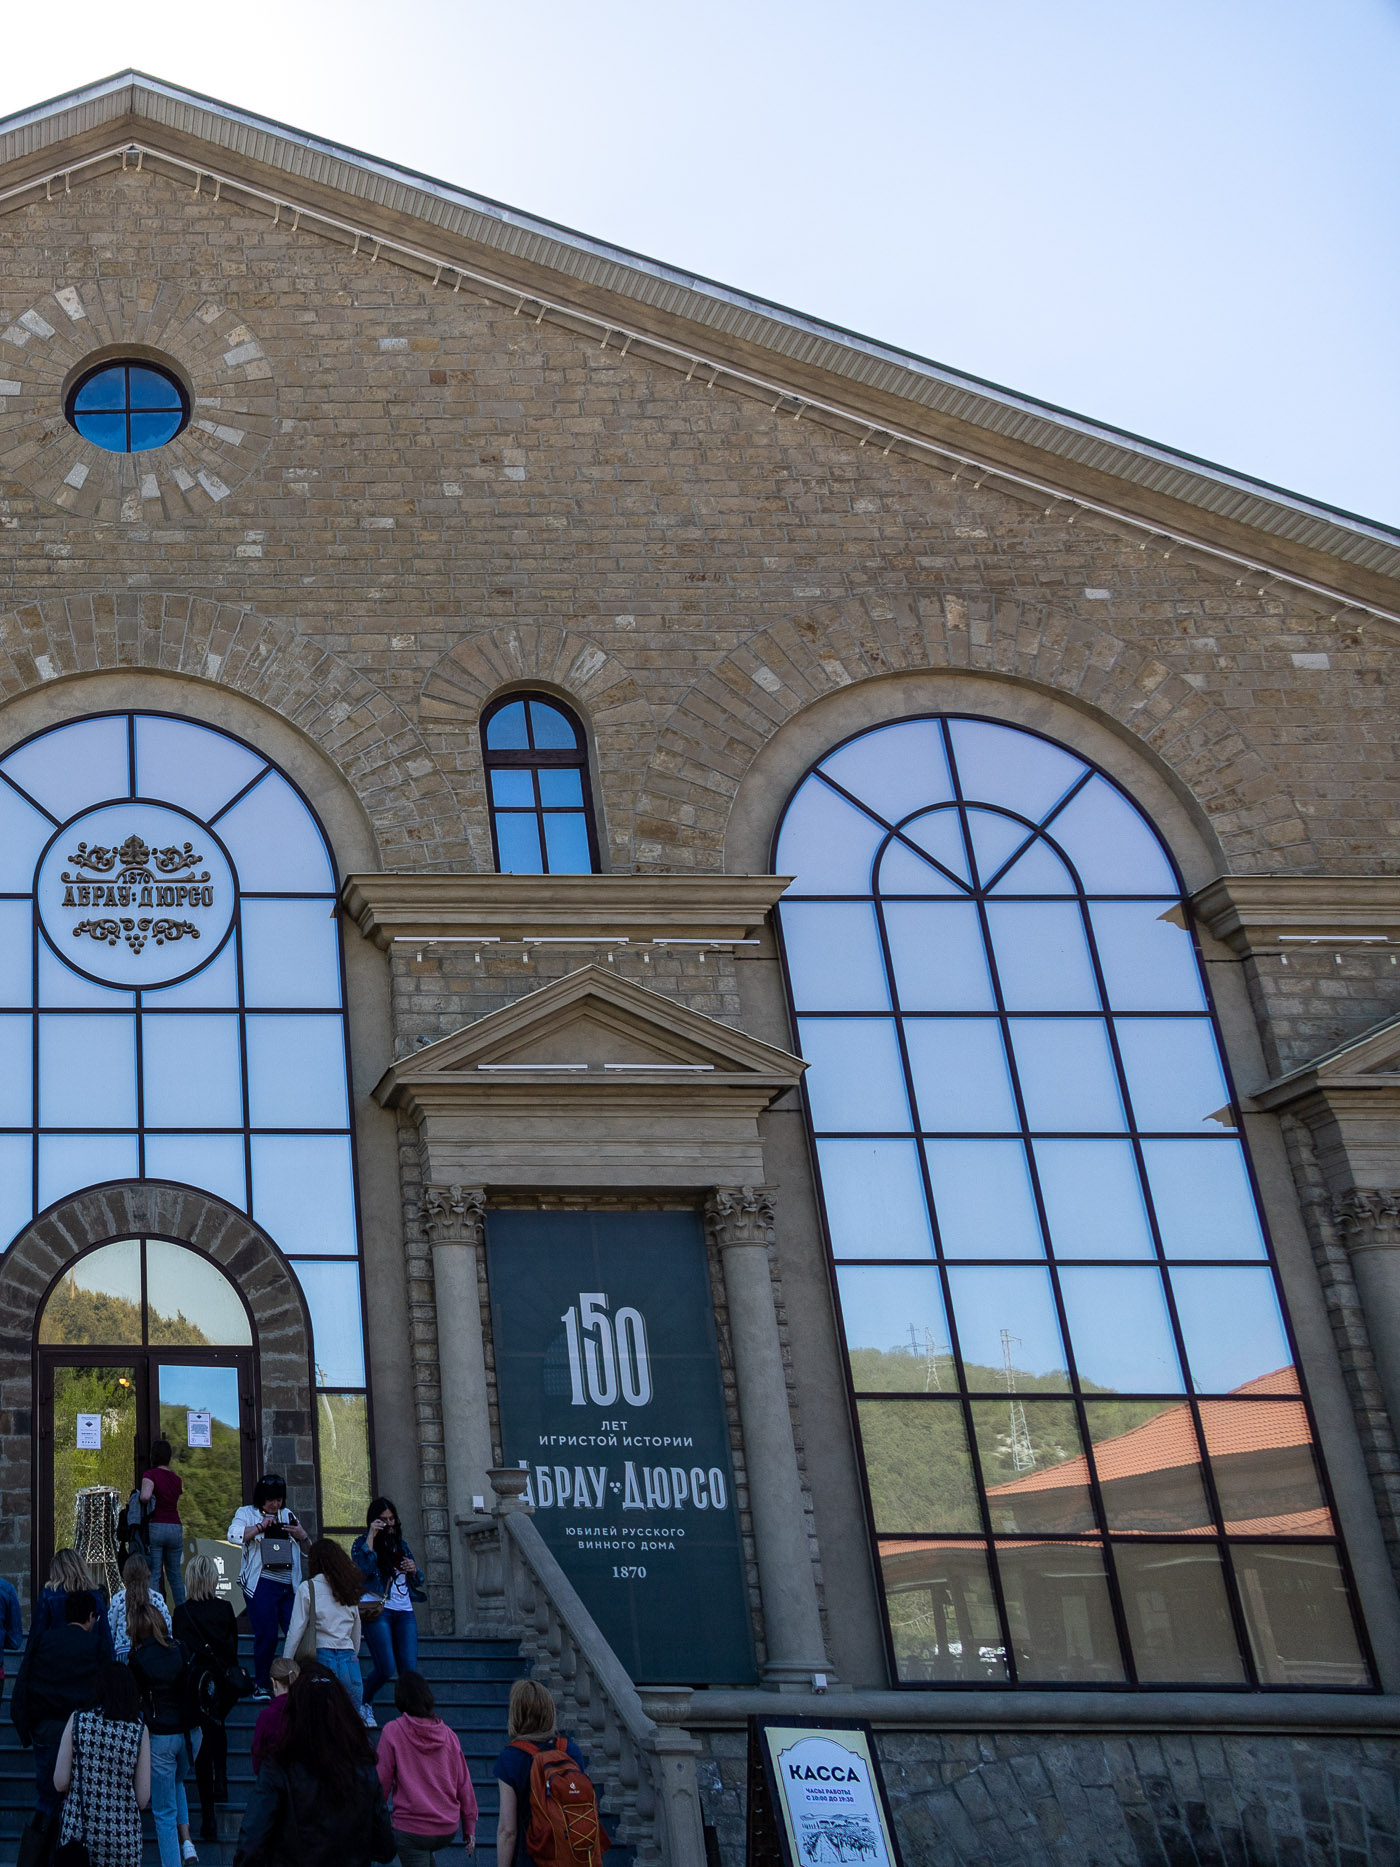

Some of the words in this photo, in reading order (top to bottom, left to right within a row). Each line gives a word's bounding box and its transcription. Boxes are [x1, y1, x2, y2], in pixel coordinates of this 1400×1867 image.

[122, 871, 151, 885] 1870
[560, 1292, 653, 1407] 150
[601, 1420, 628, 1431] ЛЕТ
[539, 1433, 618, 1447] ИГРИСТОЙ
[623, 1436, 693, 1447] ИСТОРИИ
[565, 1525, 618, 1536] ЮБИЛЕЙ
[622, 1527, 685, 1537] РУССКОГО
[578, 1541, 636, 1550] ВИННОГО
[640, 1541, 676, 1551] ДОМА
[612, 1566, 647, 1578] 1870
[788, 1764, 861, 1783] КАССА
